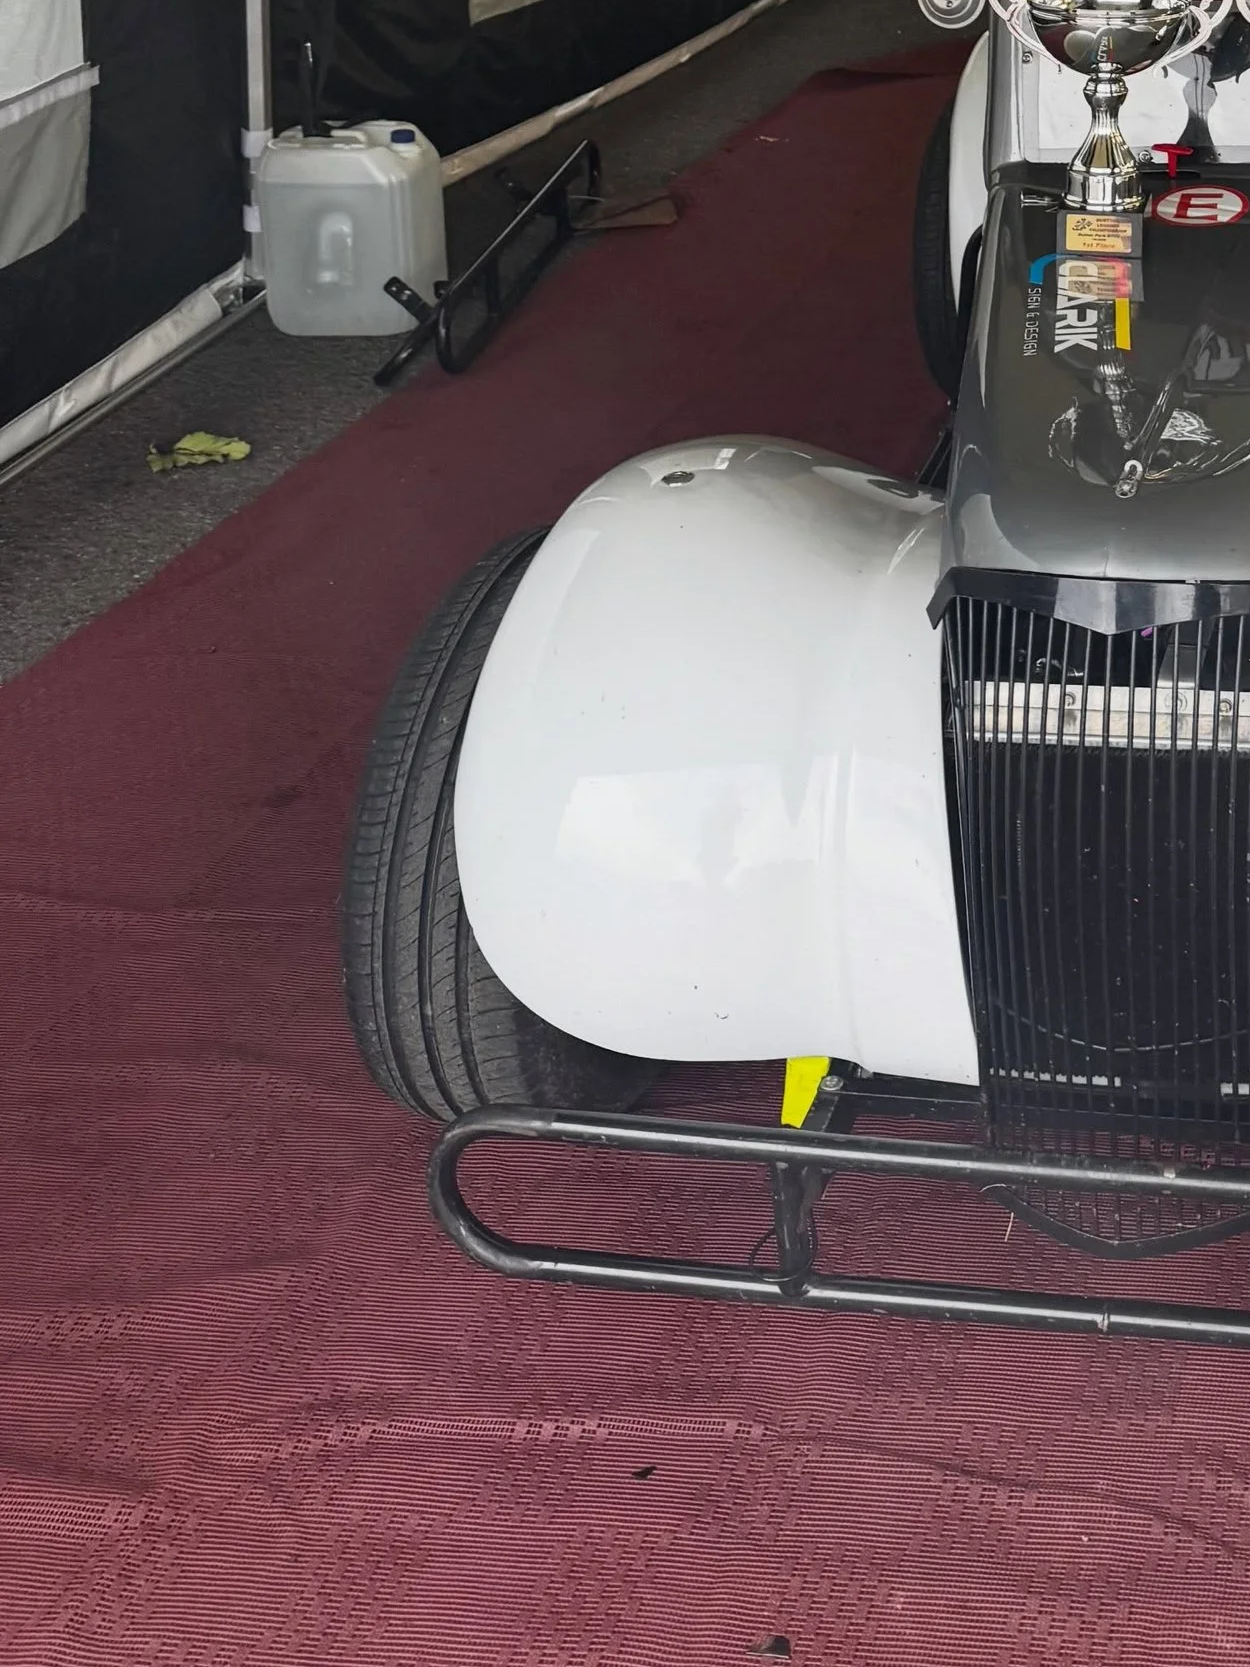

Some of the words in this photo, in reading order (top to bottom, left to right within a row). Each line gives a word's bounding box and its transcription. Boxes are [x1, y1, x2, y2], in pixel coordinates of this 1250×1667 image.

[1173, 193, 1224, 221] E
[1028, 287, 1042, 310] SIGN
[1054, 260, 1098, 353] CLARK
[1023, 321, 1039, 356] DESIGN
